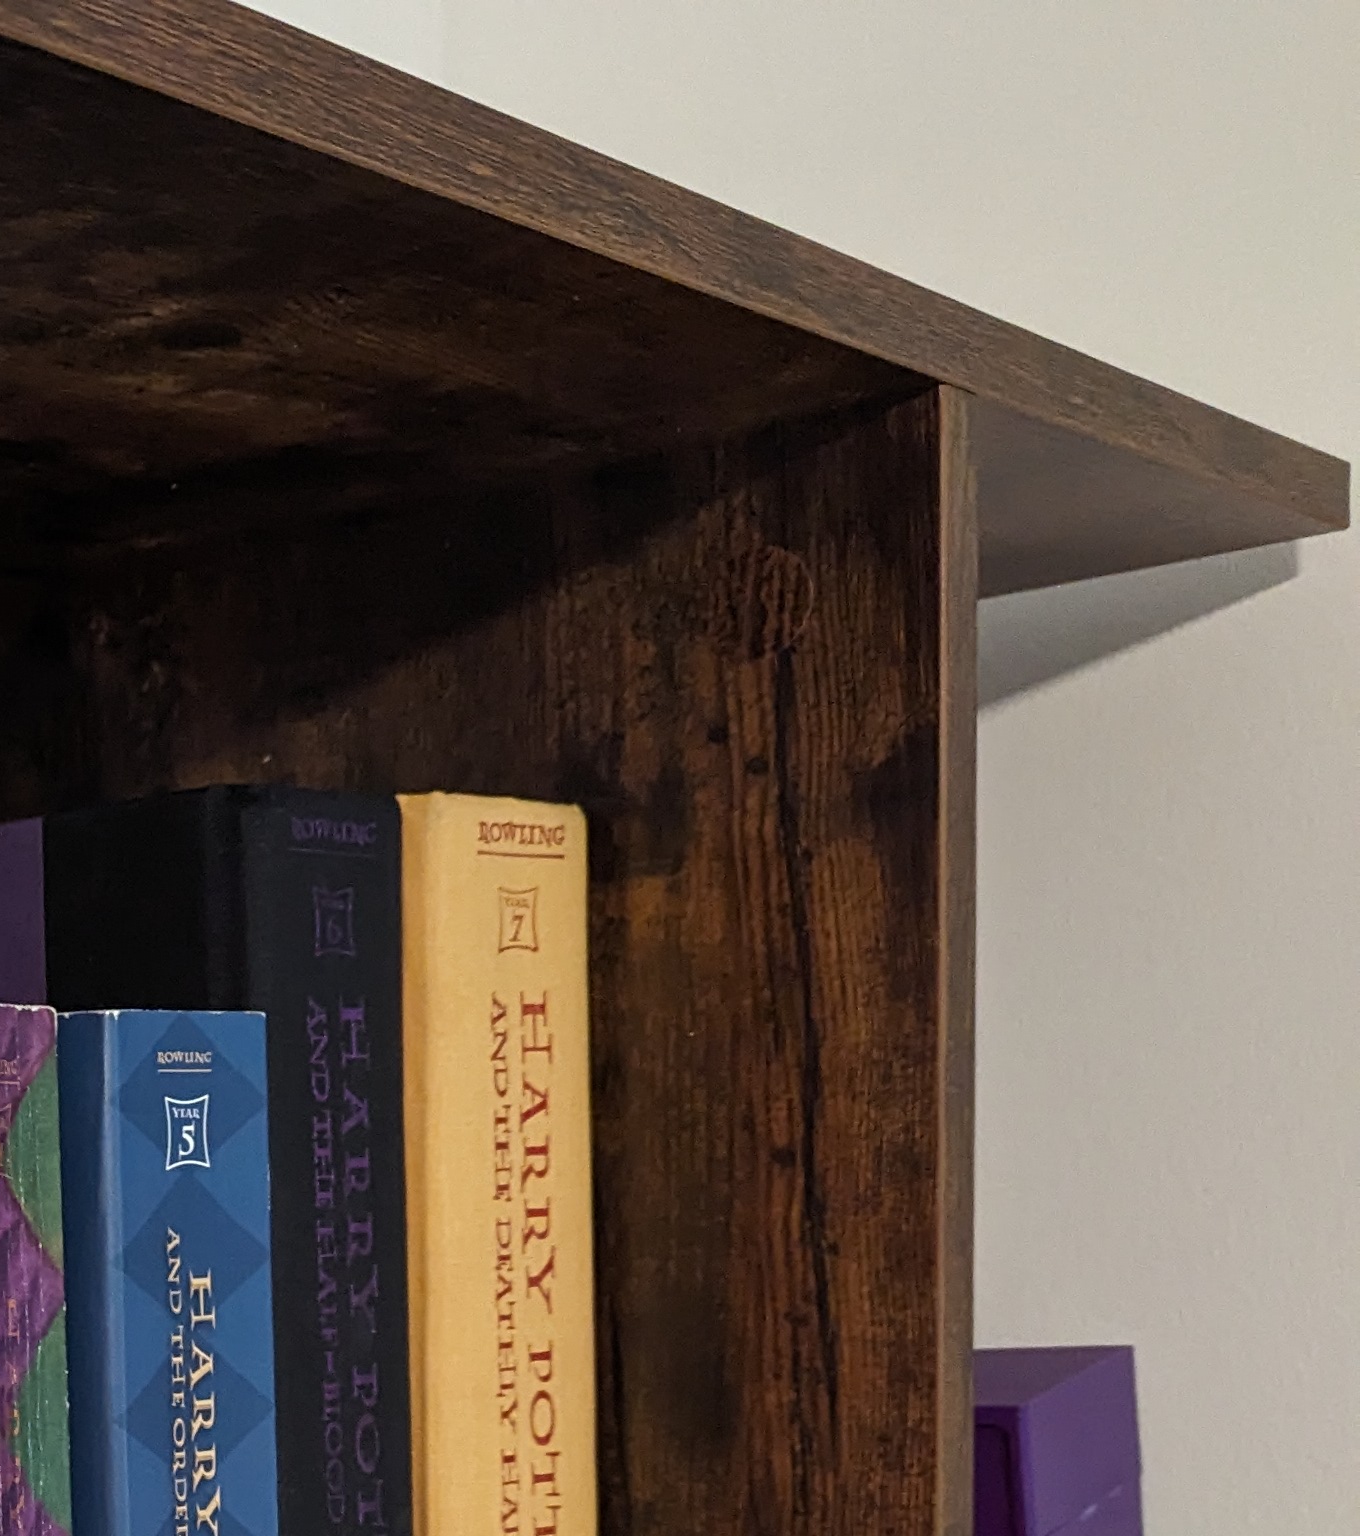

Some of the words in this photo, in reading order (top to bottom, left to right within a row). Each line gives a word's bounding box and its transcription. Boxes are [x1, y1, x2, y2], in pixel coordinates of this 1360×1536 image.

[291, 815, 377, 845] ROWLING
[478, 821, 567, 846] ROWLING
[509, 915, 525, 942] 7
[157, 1051, 212, 1063] ROWLING
[307, 995, 330, 1101] AND
[490, 990, 509, 1098] AND
[172, 1107, 200, 1119] YEAR
[179, 1120, 196, 1156] 5
[493, 1104, 513, 1202] THE
[520, 990, 556, 1315] HARRY
[312, 1109, 335, 1209] THE
[339, 995, 378, 1334] HARRY
[166, 1226, 182, 1315] AND
[170, 1325, 186, 1408] THE
[494, 1218, 519, 1434] DEATHLY
